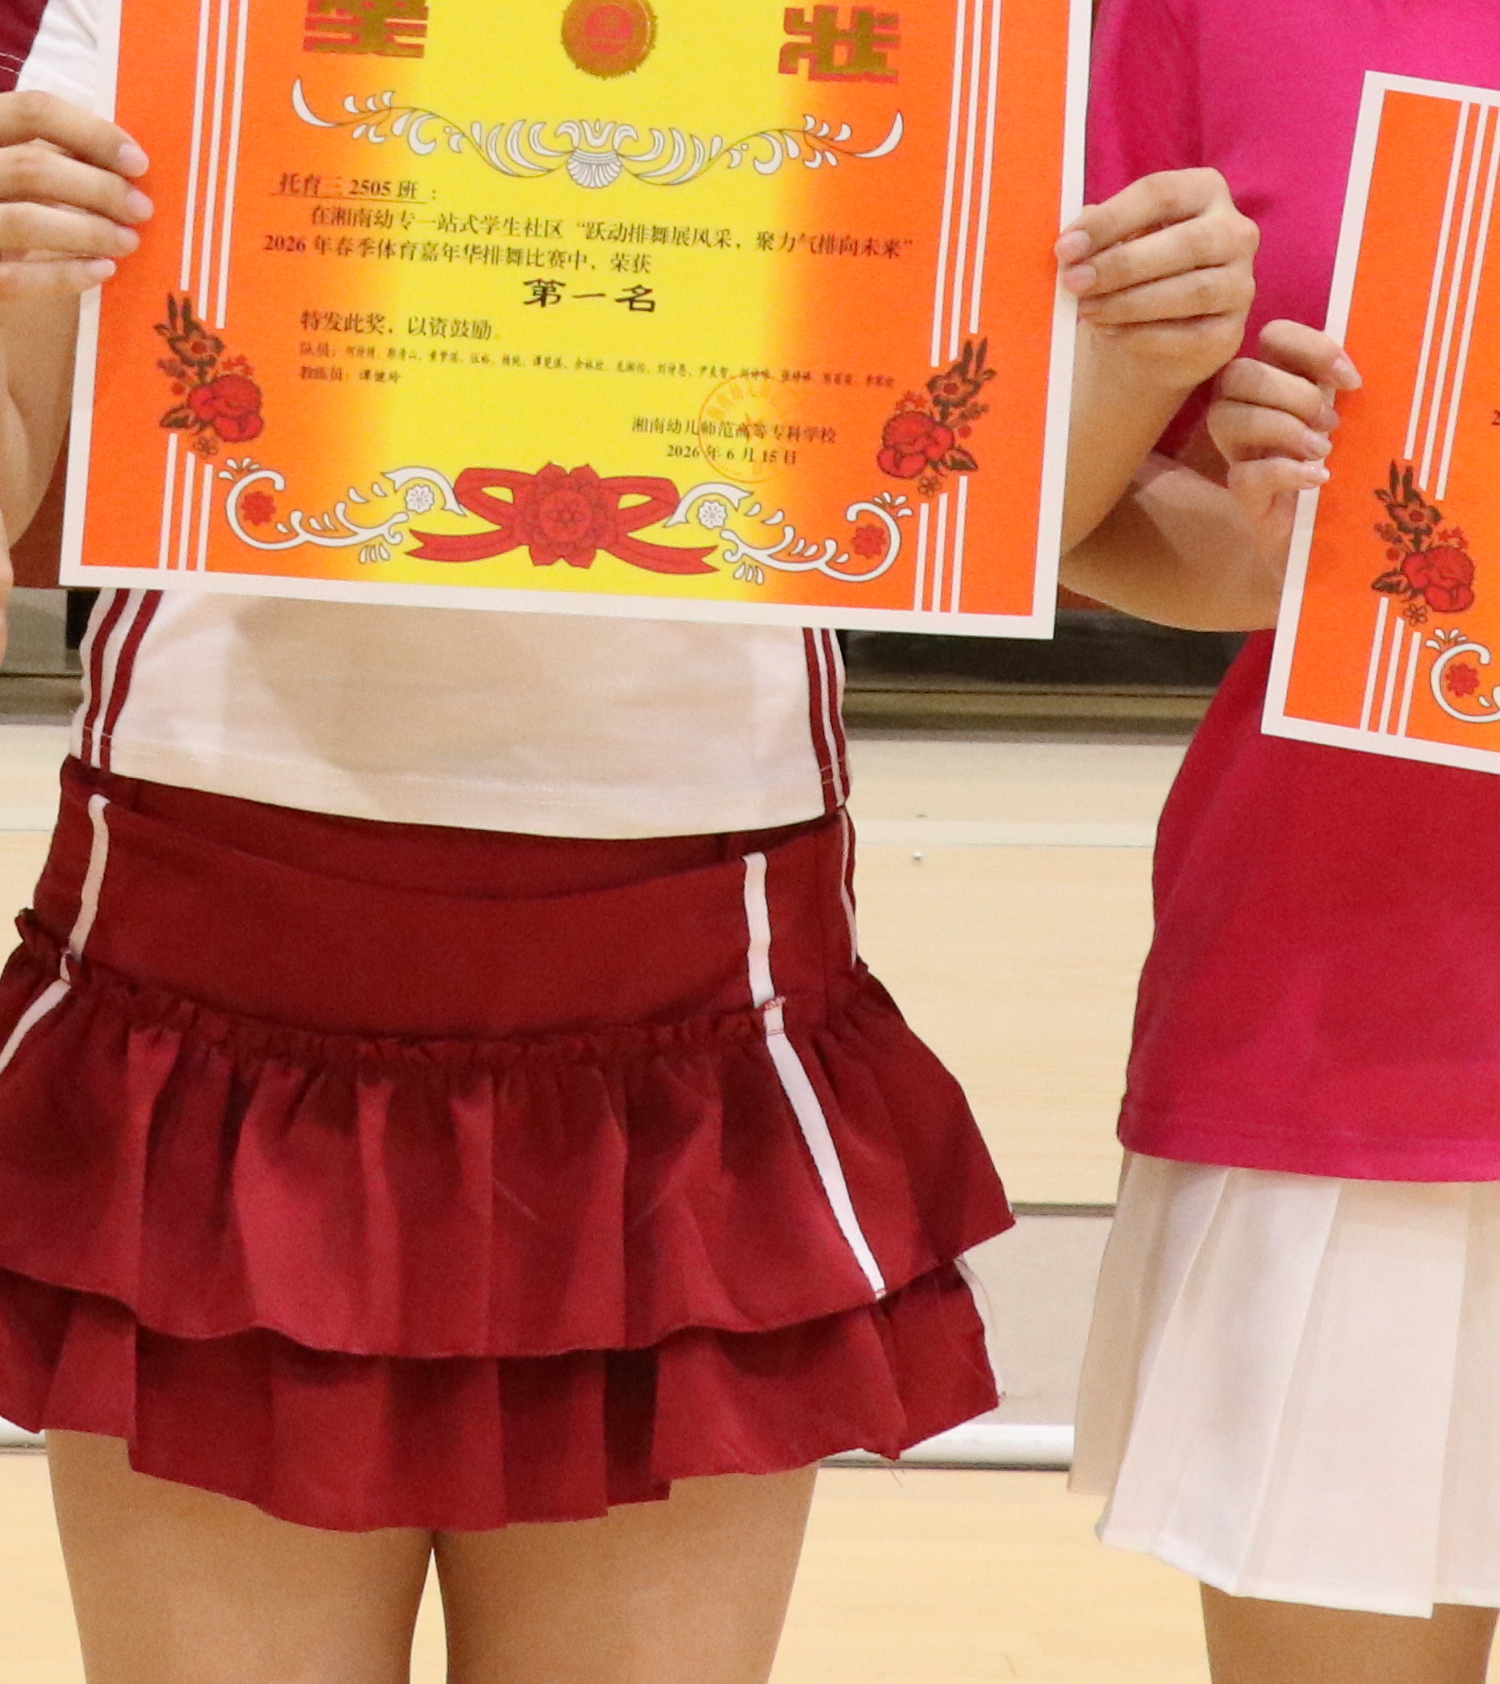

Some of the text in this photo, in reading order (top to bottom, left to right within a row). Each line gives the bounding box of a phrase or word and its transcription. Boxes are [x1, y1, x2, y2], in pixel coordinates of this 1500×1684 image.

[523, 278, 656, 313] 第一名
[632, 416, 837, 444] 湘南幼儿师范高等专科学校
